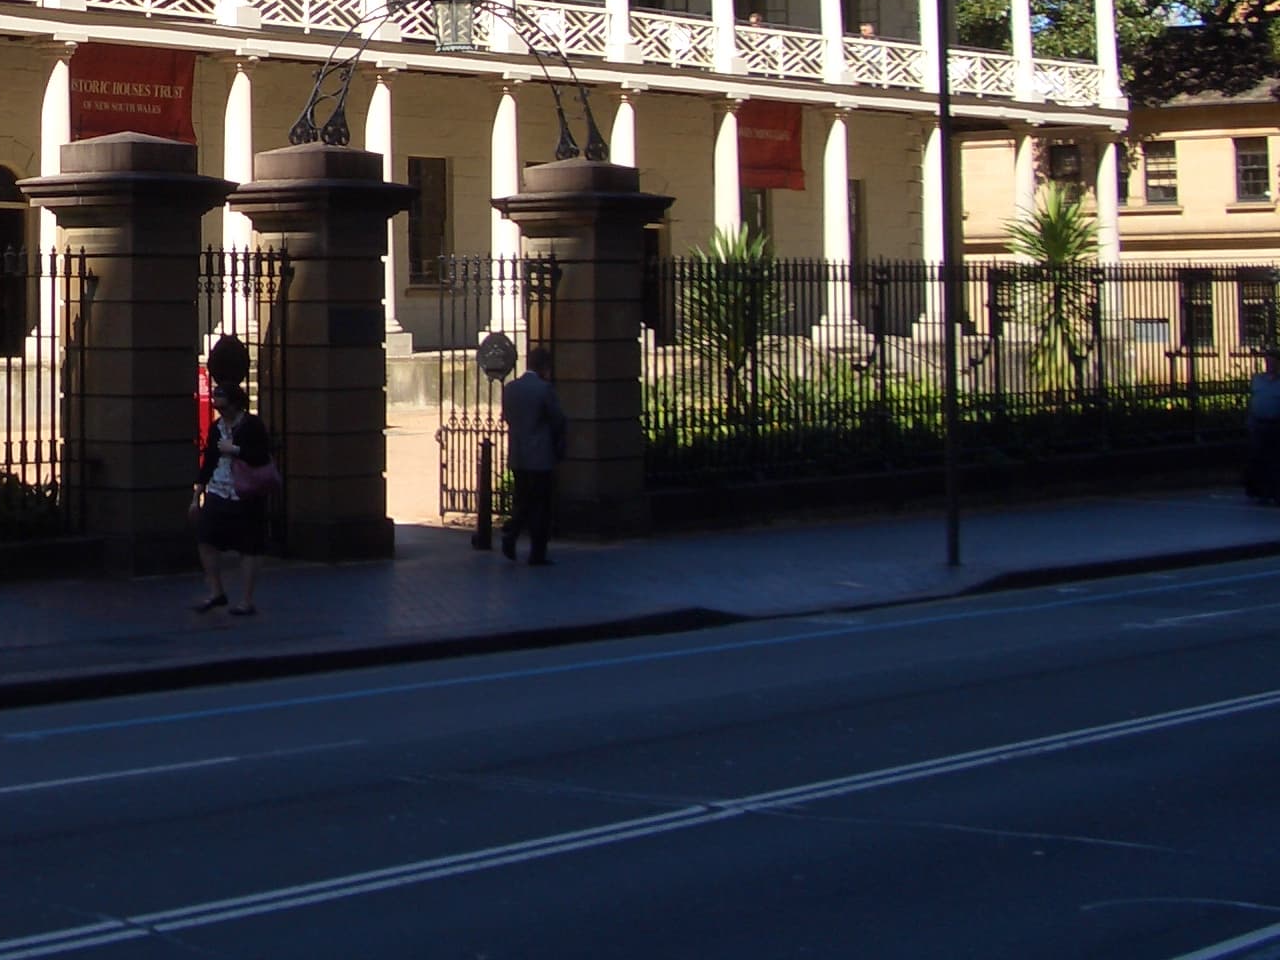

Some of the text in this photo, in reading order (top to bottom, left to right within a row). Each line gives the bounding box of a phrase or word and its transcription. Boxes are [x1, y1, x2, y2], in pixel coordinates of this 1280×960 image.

[71, 79, 184, 98] ISTORIC HOUSES TRUST
[112, 102, 136, 113] SOUTH
[137, 103, 162, 114] WALES
